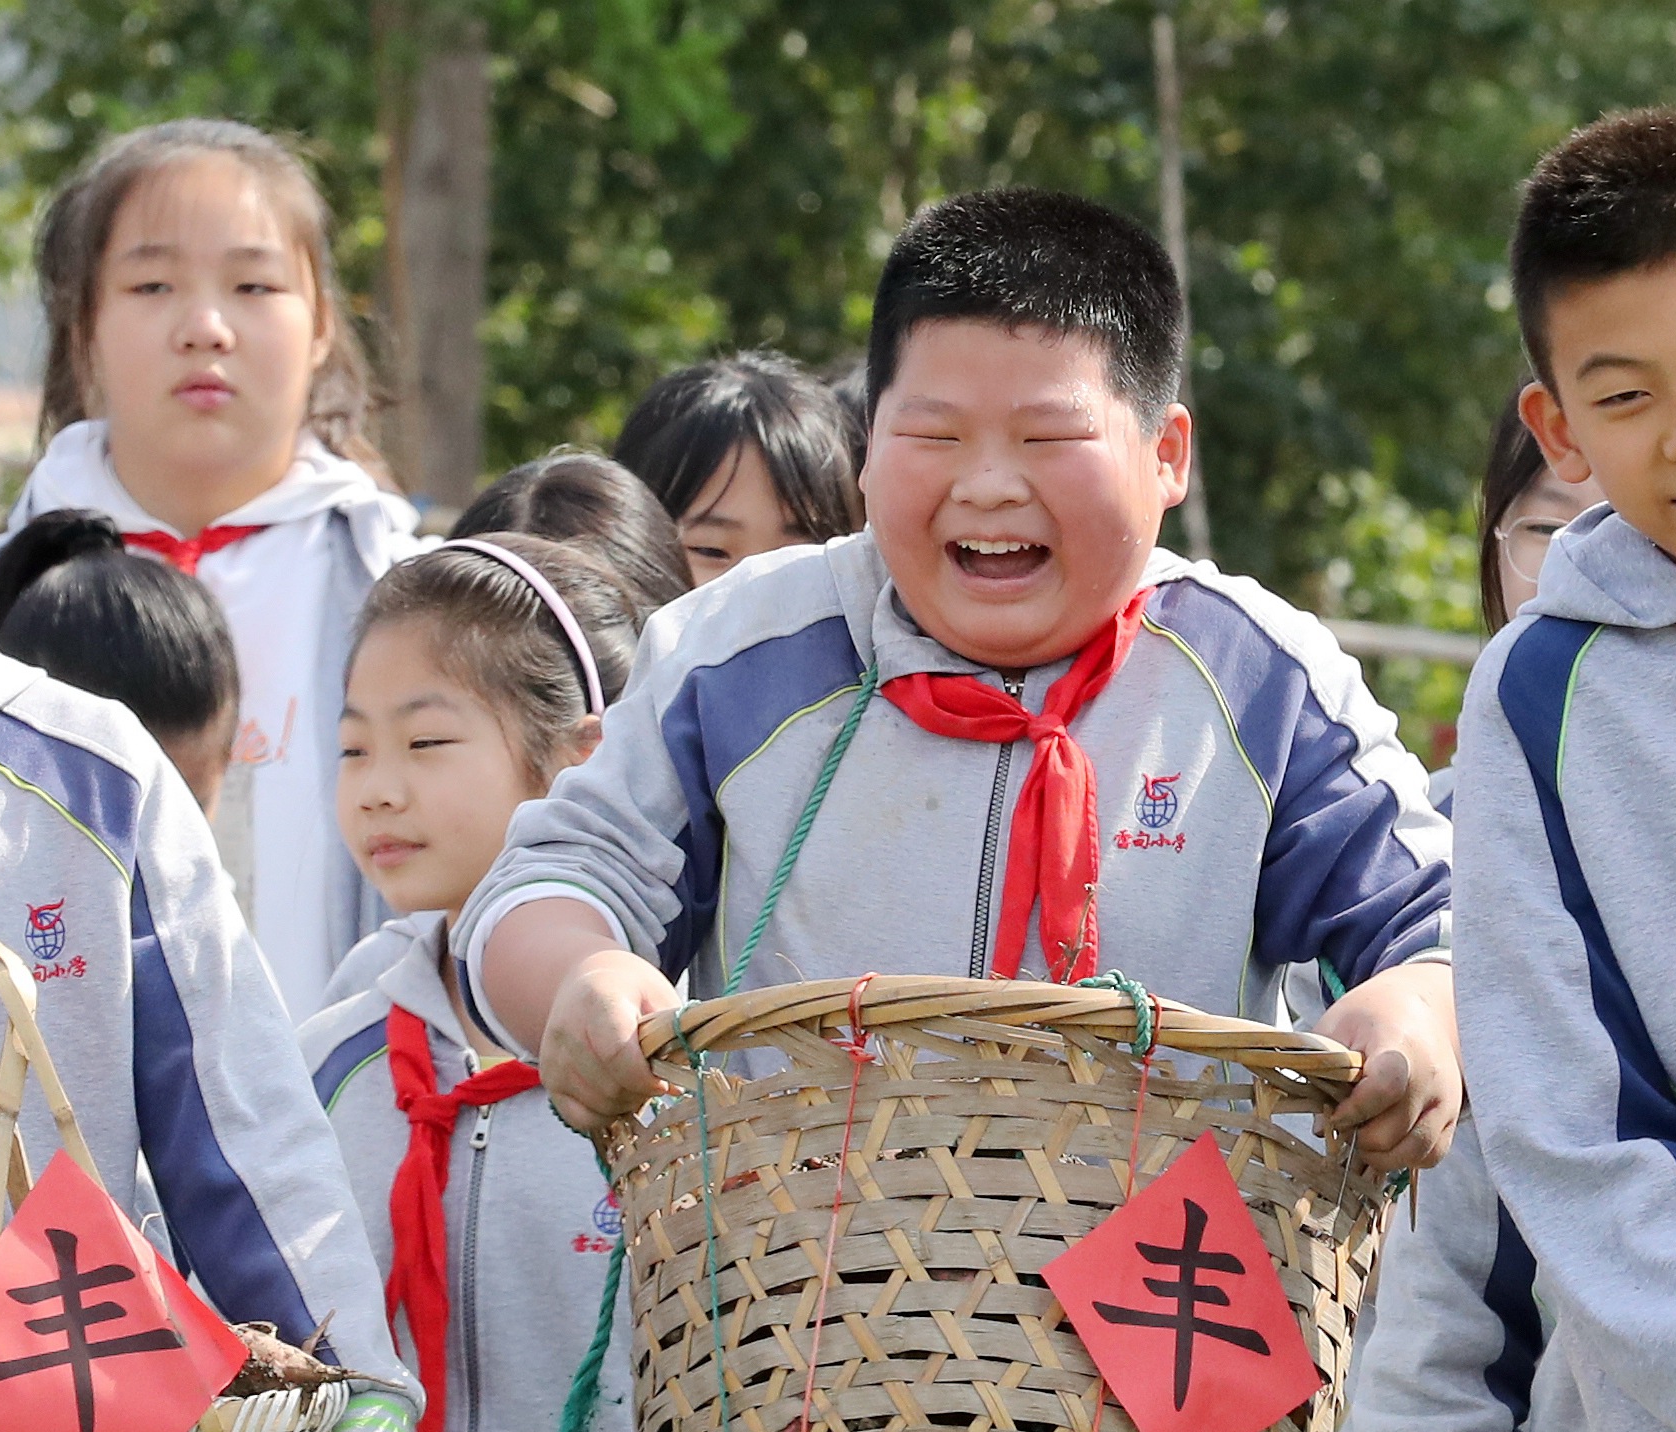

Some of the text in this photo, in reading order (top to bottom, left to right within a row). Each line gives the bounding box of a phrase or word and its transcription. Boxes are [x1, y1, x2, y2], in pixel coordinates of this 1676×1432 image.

[32, 955, 86, 983] 甸小学
[1093, 1198, 1271, 1412] 丰
